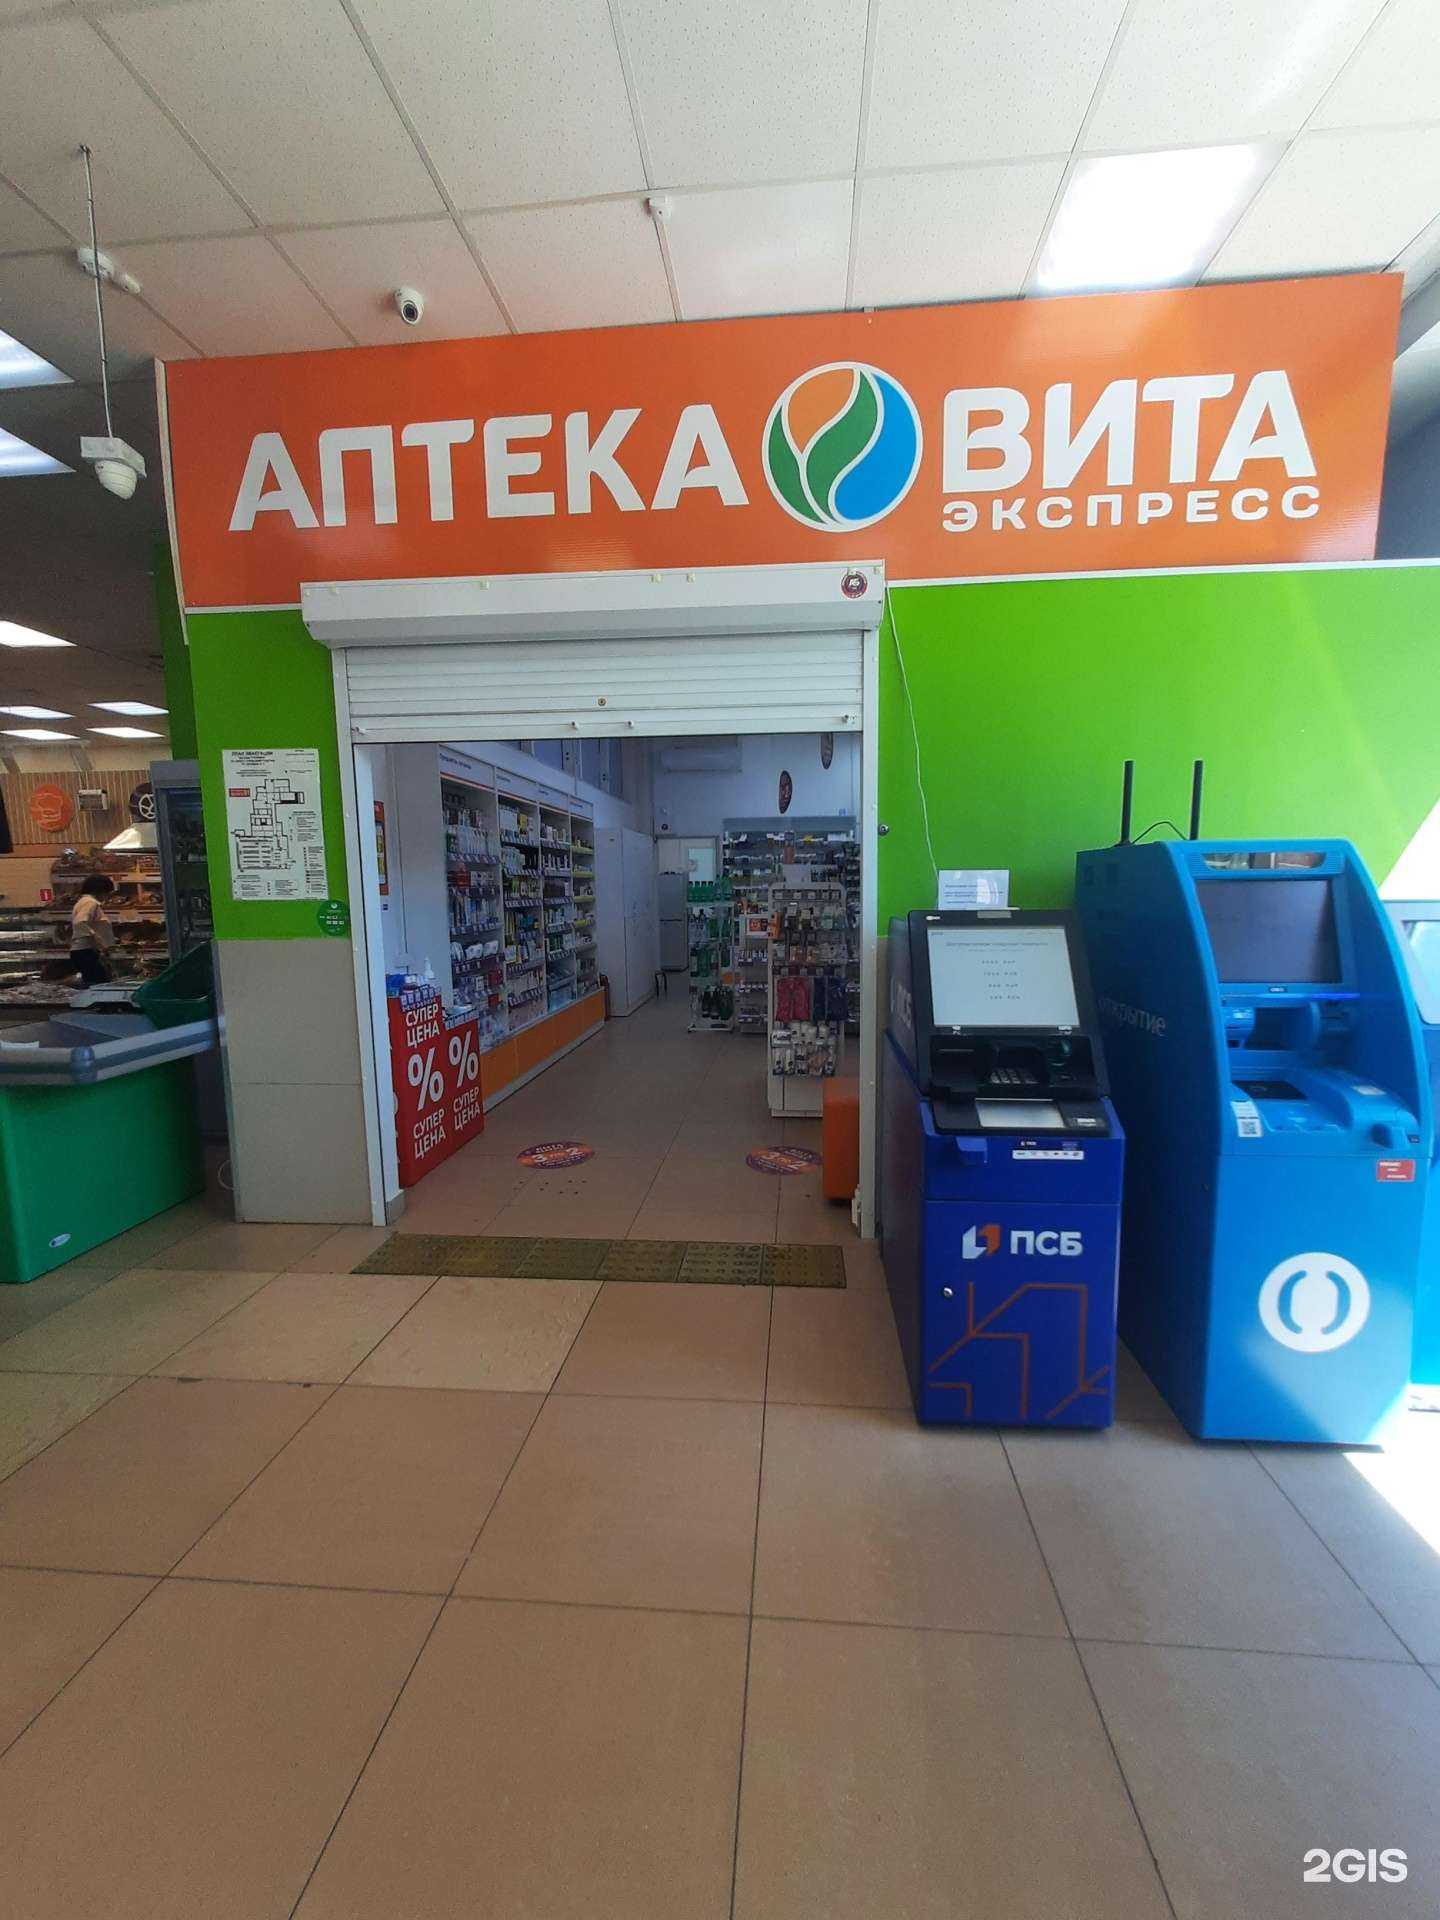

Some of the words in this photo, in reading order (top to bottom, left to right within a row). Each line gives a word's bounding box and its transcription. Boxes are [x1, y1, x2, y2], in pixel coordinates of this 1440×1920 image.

[229, 403, 750, 532] АПТЕКА
[942, 370, 1318, 494] ВИТА
[942, 484, 1321, 533] ЭКСПРЕСС
[405, 1003, 440, 1027] СУПЕР
[406, 1022, 441, 1049] ЦЕНА
[453, 1087, 480, 1113] СУПЕР
[413, 1108, 446, 1139] СУПЕР
[454, 1105, 481, 1131] ЦЕНА
[414, 1127, 447, 1160] ЦЕНА
[1009, 1229, 1084, 1257] ПСБ
